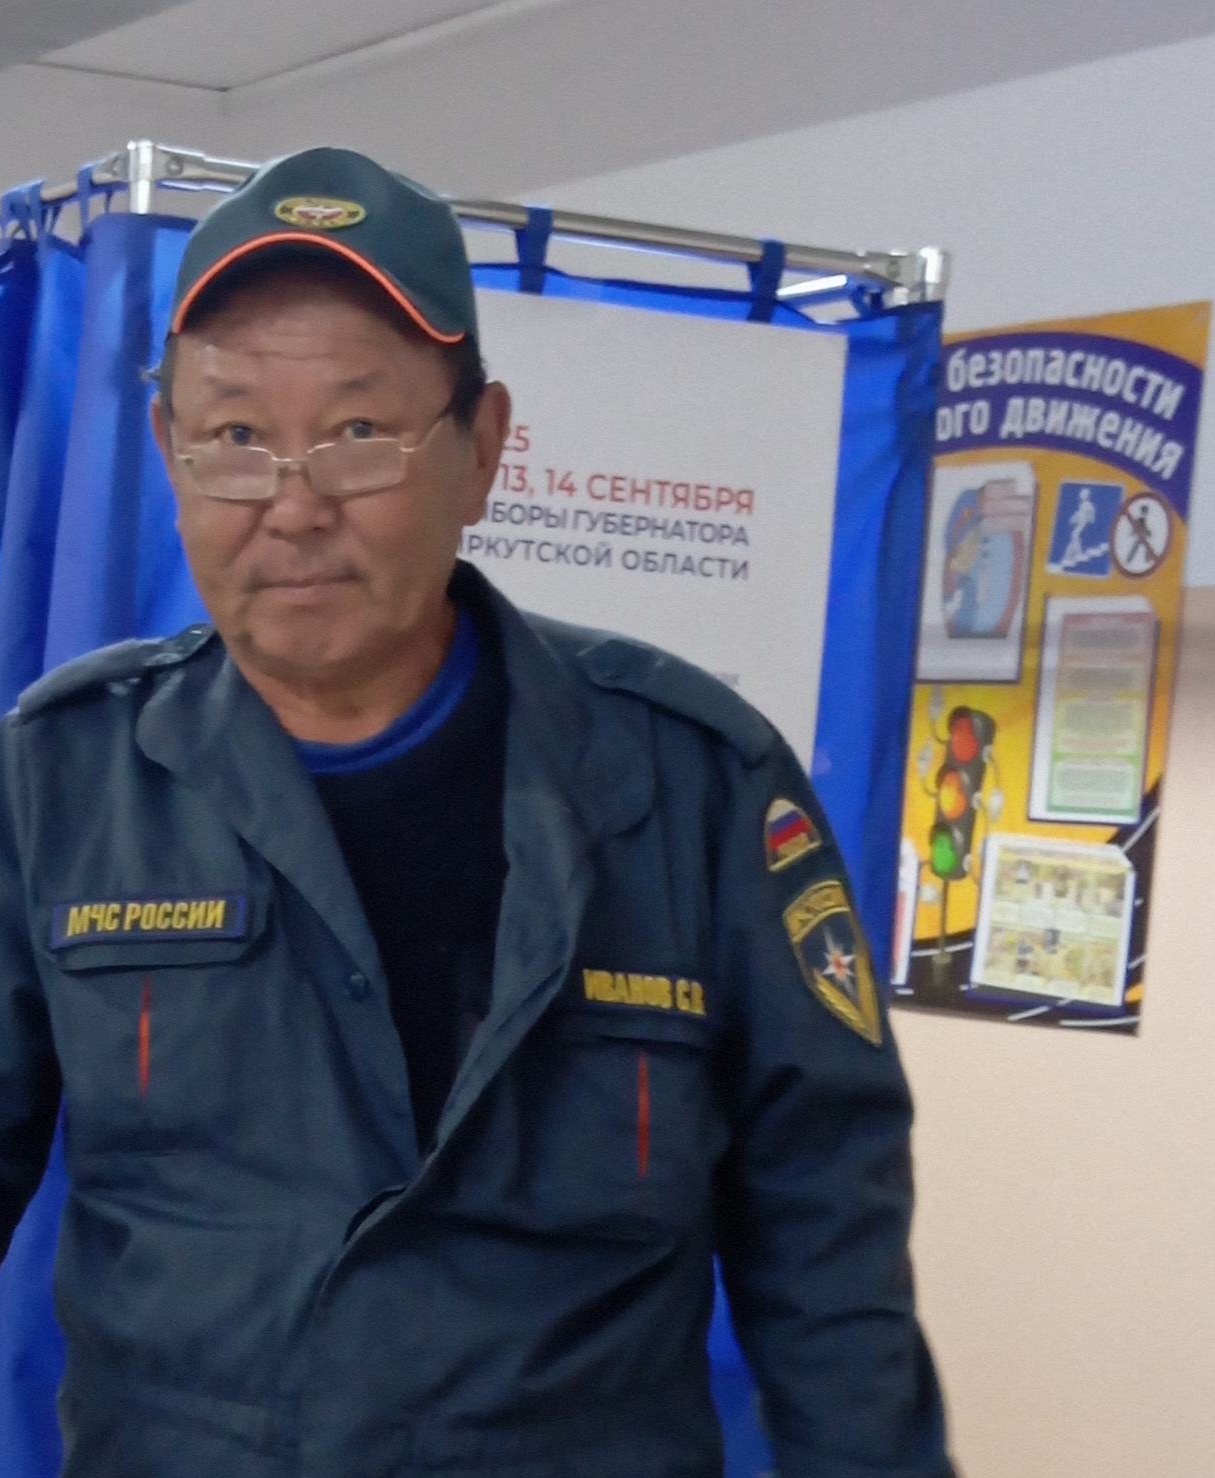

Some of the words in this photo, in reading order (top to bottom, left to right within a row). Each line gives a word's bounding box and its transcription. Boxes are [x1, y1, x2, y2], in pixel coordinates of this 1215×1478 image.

[947, 347, 1185, 421] безопасности
[999, 396, 1185, 480] движения
[544, 467, 577, 497] 14
[586, 473, 755, 515] СЕНТЯБРЯ
[485, 500, 567, 530] БОРЫ
[572, 509, 750, 546] ГУБЕРНАТОРА
[621, 549, 749, 580] ОБЛАСТИ
[66, 903, 122, 937] МЧС
[123, 899, 227, 932] РОССИИ
